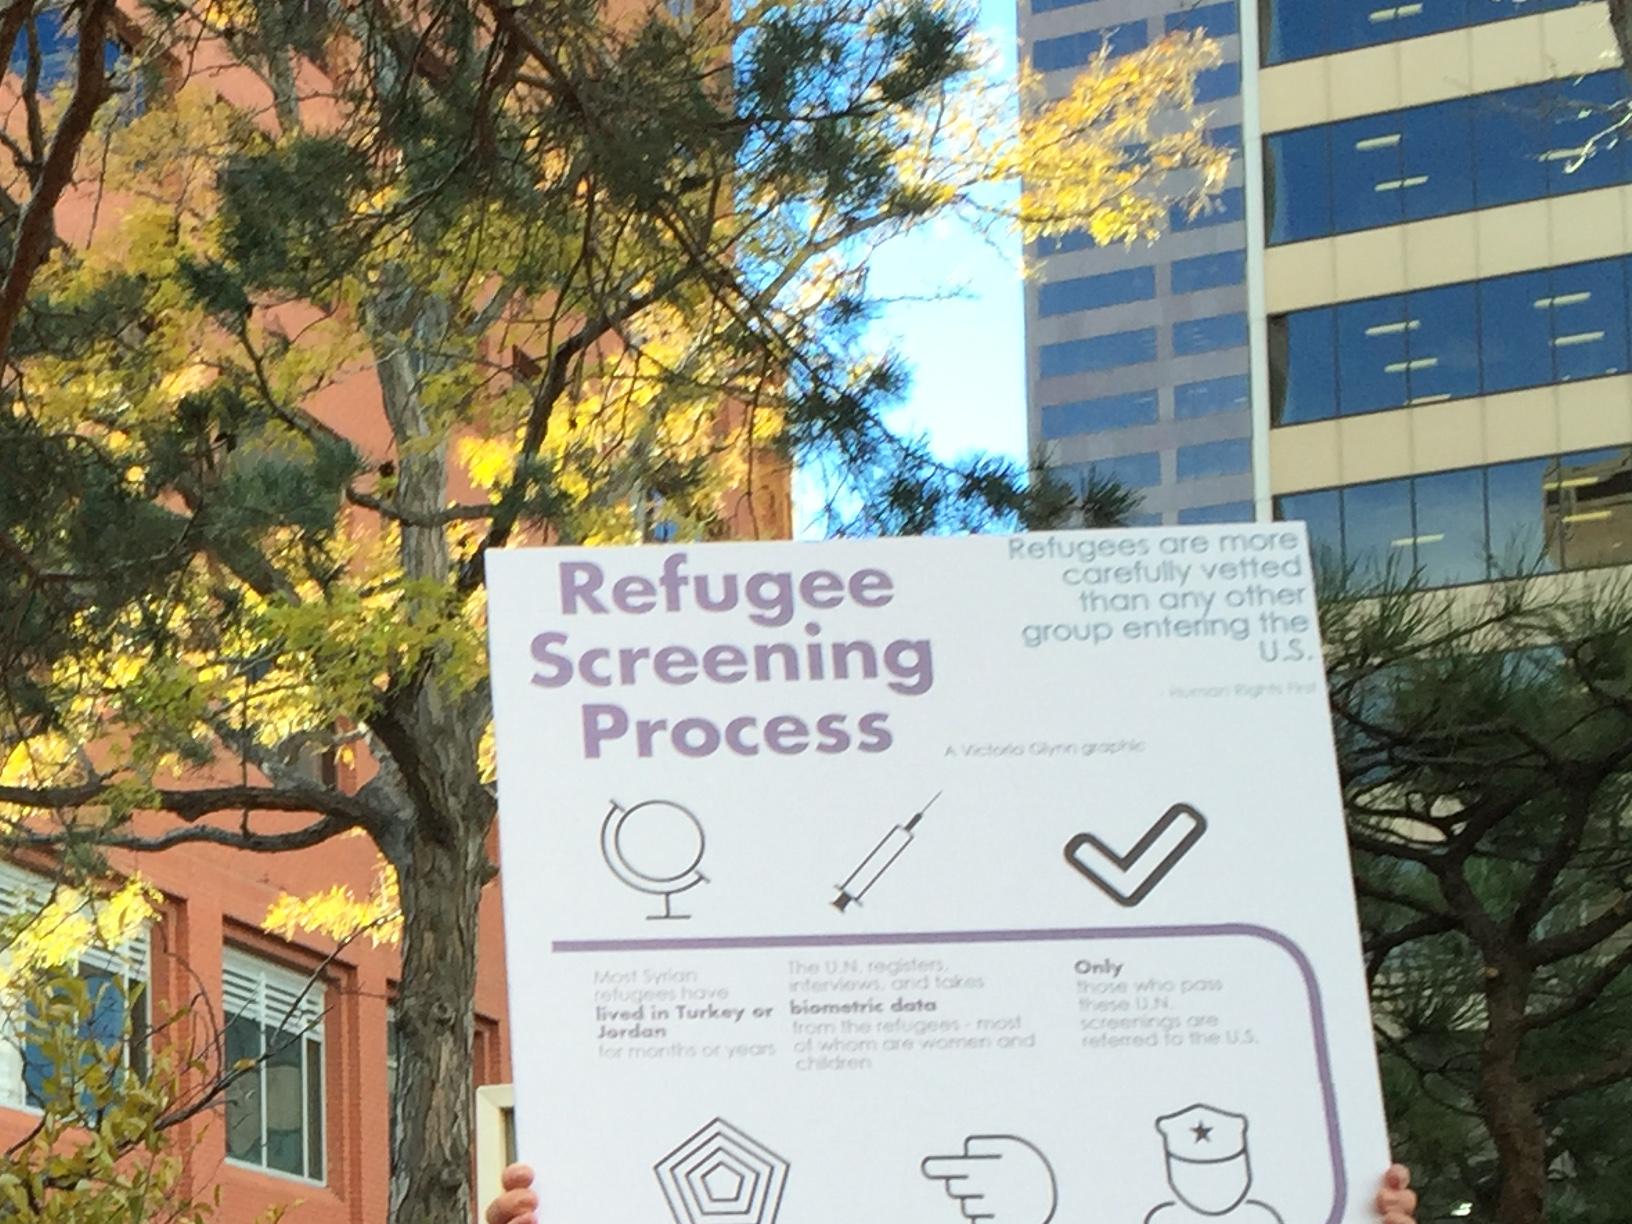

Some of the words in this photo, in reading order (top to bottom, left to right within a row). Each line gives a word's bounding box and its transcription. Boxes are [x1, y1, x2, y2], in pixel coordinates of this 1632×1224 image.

[1008, 536, 1149, 562] Refugees
[1159, 537, 1208, 555] are
[1219, 530, 1298, 552] more
[1063, 562, 1191, 586] carefully
[1203, 556, 1302, 579] vetted
[560, 553, 894, 626] Refugee
[1079, 589, 1149, 613] than
[1159, 590, 1216, 619] any
[1228, 584, 1306, 607] other
[1022, 622, 1113, 648] group
[1123, 613, 1249, 641] entering
[1260, 611, 1310, 634] the
[530, 622, 934, 696] Screening
[1259, 639, 1314, 662] U.S.
[582, 704, 893, 758] Process
[945, 744, 956, 757] A
[594, 970, 638, 984] Most
[642, 968, 697, 986] Syrian
[788, 960, 820, 975] The
[1074, 960, 1123, 977] Only
[891, 974, 928, 990] and
[935, 974, 984, 989] takes
[1076, 979, 1129, 993] those
[1134, 978, 1176, 992] who
[1180, 979, 1223, 996] pass
[594, 986, 677, 1004] refugees
[682, 985, 729, 999] have
[1078, 996, 1129, 1012] these
[596, 1004, 646, 1022] lived
[650, 1005, 670, 1020] in
[676, 1005, 745, 1023] Turkey
[752, 1008, 773, 1018] or
[790, 999, 882, 1014] biometric
[891, 998, 936, 1013] data
[597, 1024, 666, 1040] Jordan
[792, 1018, 836, 1034] from
[841, 1017, 871, 1033] the
[876, 1017, 960, 1037] refugees
[976, 1015, 1022, 1031] most
[1081, 1014, 1181, 1031] screenings
[1187, 1015, 1219, 1027] are
[794, 1037, 813, 1052] of
[818, 1036, 878, 1052] whom
[883, 1038, 914, 1050] are
[918, 1037, 991, 1050] women
[996, 1033, 1035, 1049] and
[1081, 1032, 1157, 1049] referred
[1164, 1033, 1183, 1047] to
[1189, 1031, 1219, 1046] the
[1225, 1030, 1260, 1045] U.S.
[599, 1044, 624, 1058] for
[629, 1043, 698, 1058] months
[703, 1045, 724, 1056] or
[728, 1044, 776, 1060] years
[796, 1055, 871, 1071] children
